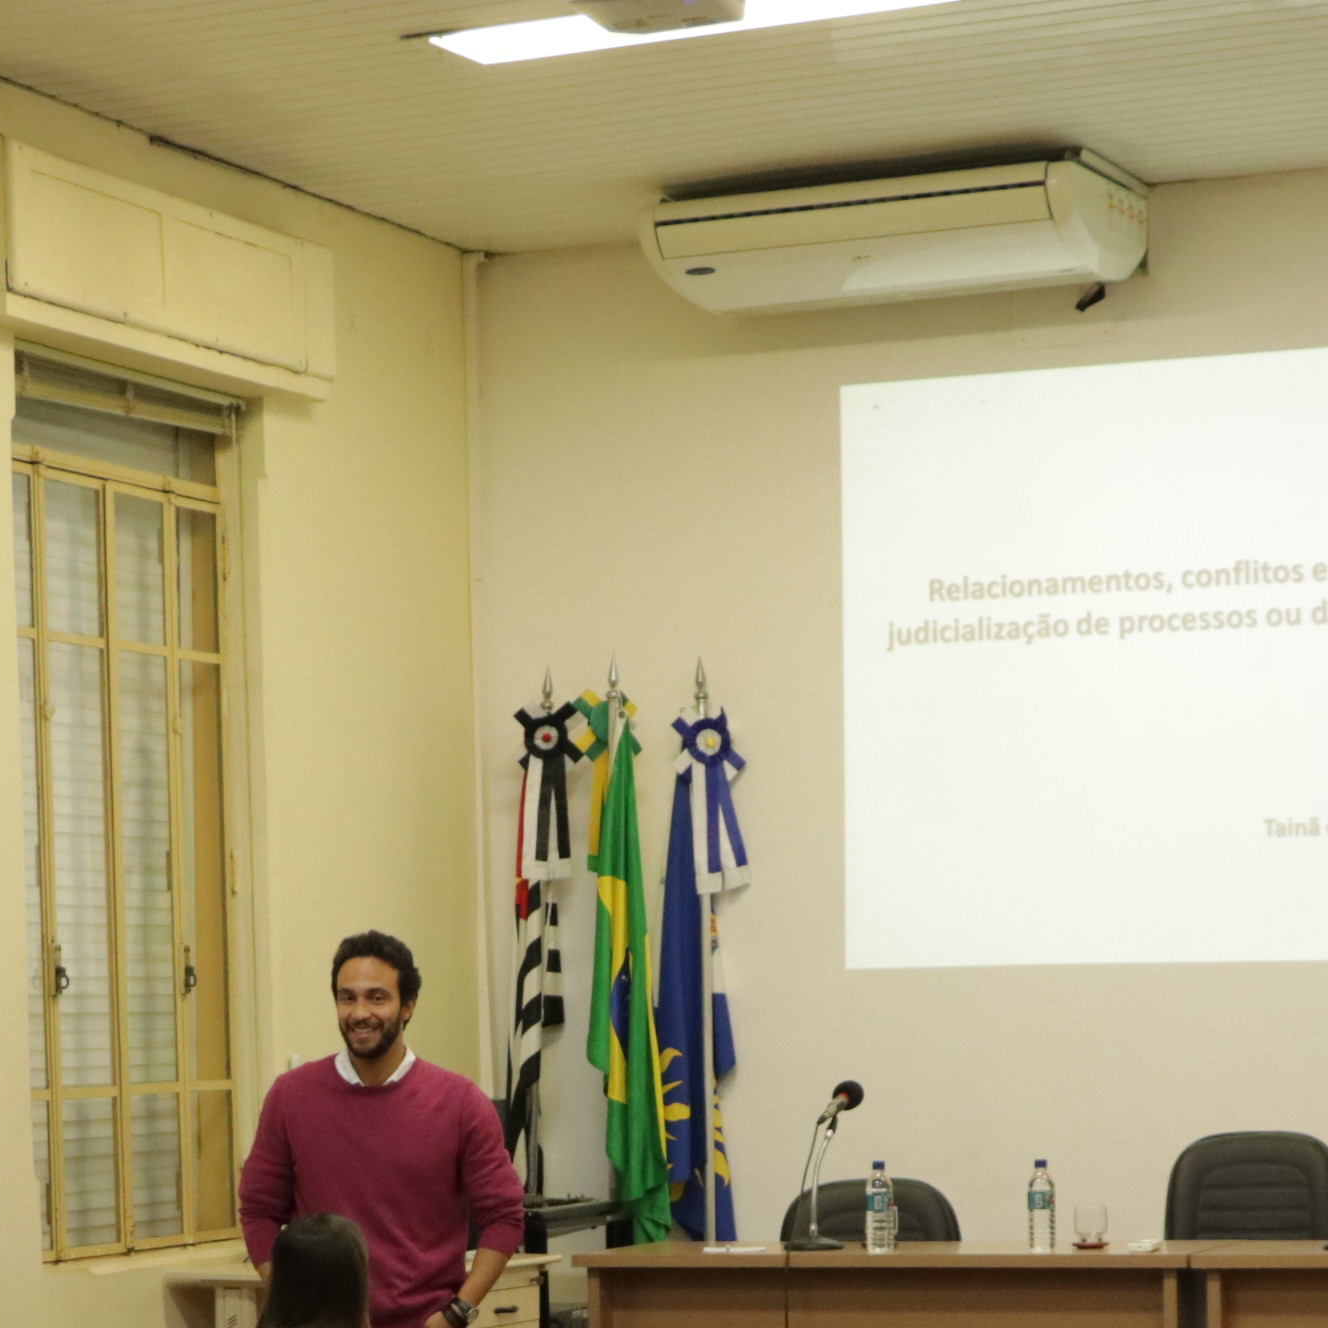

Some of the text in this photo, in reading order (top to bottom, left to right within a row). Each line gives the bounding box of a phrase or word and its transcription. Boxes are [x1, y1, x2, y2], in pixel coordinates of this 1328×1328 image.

[928, 569, 1174, 602] Relacionamentos,
[1180, 558, 1305, 588] conflitos
[1312, 561, 1328, 582] e
[886, 612, 1070, 652] judicialização
[1076, 610, 1110, 636] de
[1119, 608, 1258, 640] processos
[1266, 606, 1302, 627] ou
